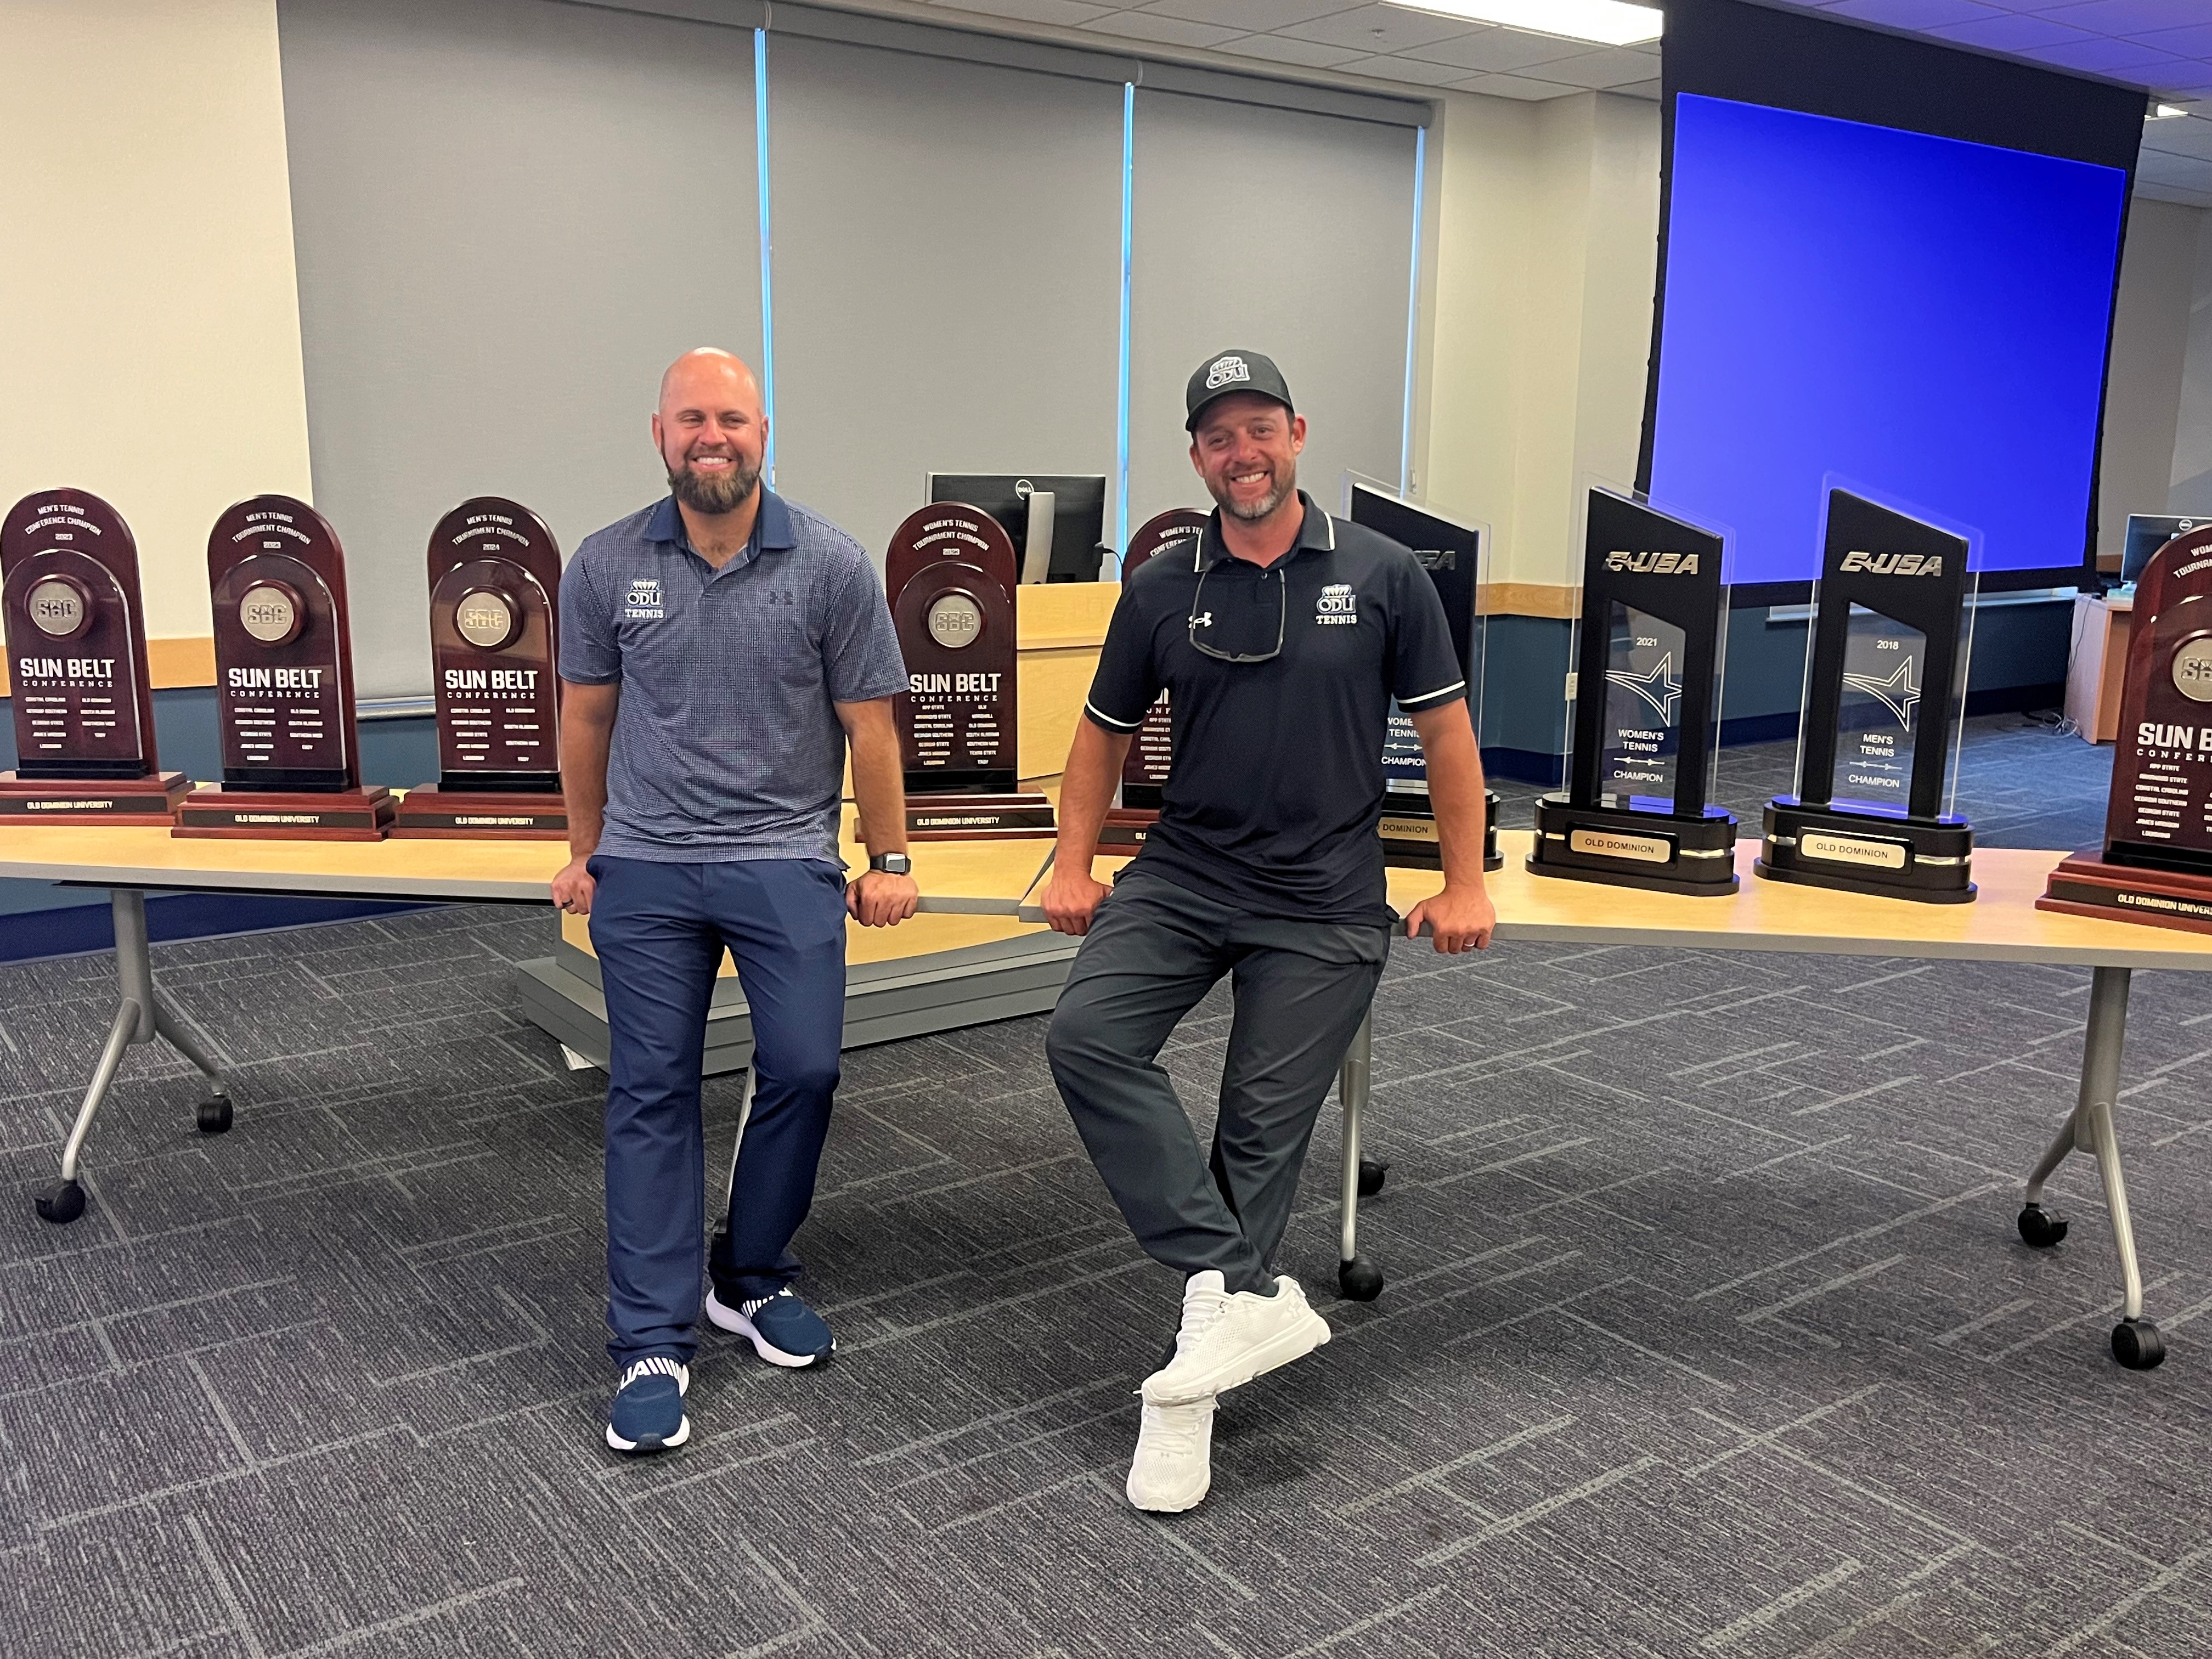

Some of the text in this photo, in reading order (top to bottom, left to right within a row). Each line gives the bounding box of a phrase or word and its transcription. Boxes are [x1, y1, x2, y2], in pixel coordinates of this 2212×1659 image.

[37, 505, 84, 515] MEN'S TENNIS
[246, 512, 293, 523] MEN'S TENNIS
[466, 514, 513, 526] MEN'S TENNIS
[25, 517, 101, 535] CONFERENCE CHAMPION
[923, 520, 979, 532] WOMEN'S TENNIS
[1159, 526, 1190, 538] WOMEN'S
[232, 524, 311, 545] TOURNAMENT CHAMPION
[452, 527, 530, 547] TOURNAMENT CHAMPION
[913, 532, 989, 551] TOURNAMENT CHAMPION
[626, 591, 662, 606] ODU
[1318, 597, 1355, 613] ODU
[625, 609, 663, 618] TENNIS
[1316, 614, 1357, 624] TENNIS
[1636, 637, 1657, 646] 2021
[1877, 640, 1899, 650] 2018
[20, 658, 115, 678] SUN BELT
[229, 668, 322, 689] SUN BELT
[445, 669, 538, 690] SUN BELT
[910, 673, 1001, 693] SUN BELT
[230, 690, 319, 698] CONFERENCE
[1618, 729, 1664, 741] WOMEN'S
[1863, 733, 1893, 744] MEN'S
[2137, 723, 2193, 749] SUN
[1623, 741, 1658, 752] TENNIS
[1860, 746, 1894, 757] TENNIS
[1613, 771, 1663, 782] CHAMPION
[1849, 774, 1900, 788] CHAMPION
[1383, 823, 1428, 833] DOMINION
[1585, 838, 1654, 853] OLD DOMINION
[1816, 843, 1888, 859] OLD DOMINION
[2118, 894, 2212, 915] OLD DOMINION UNIVER
